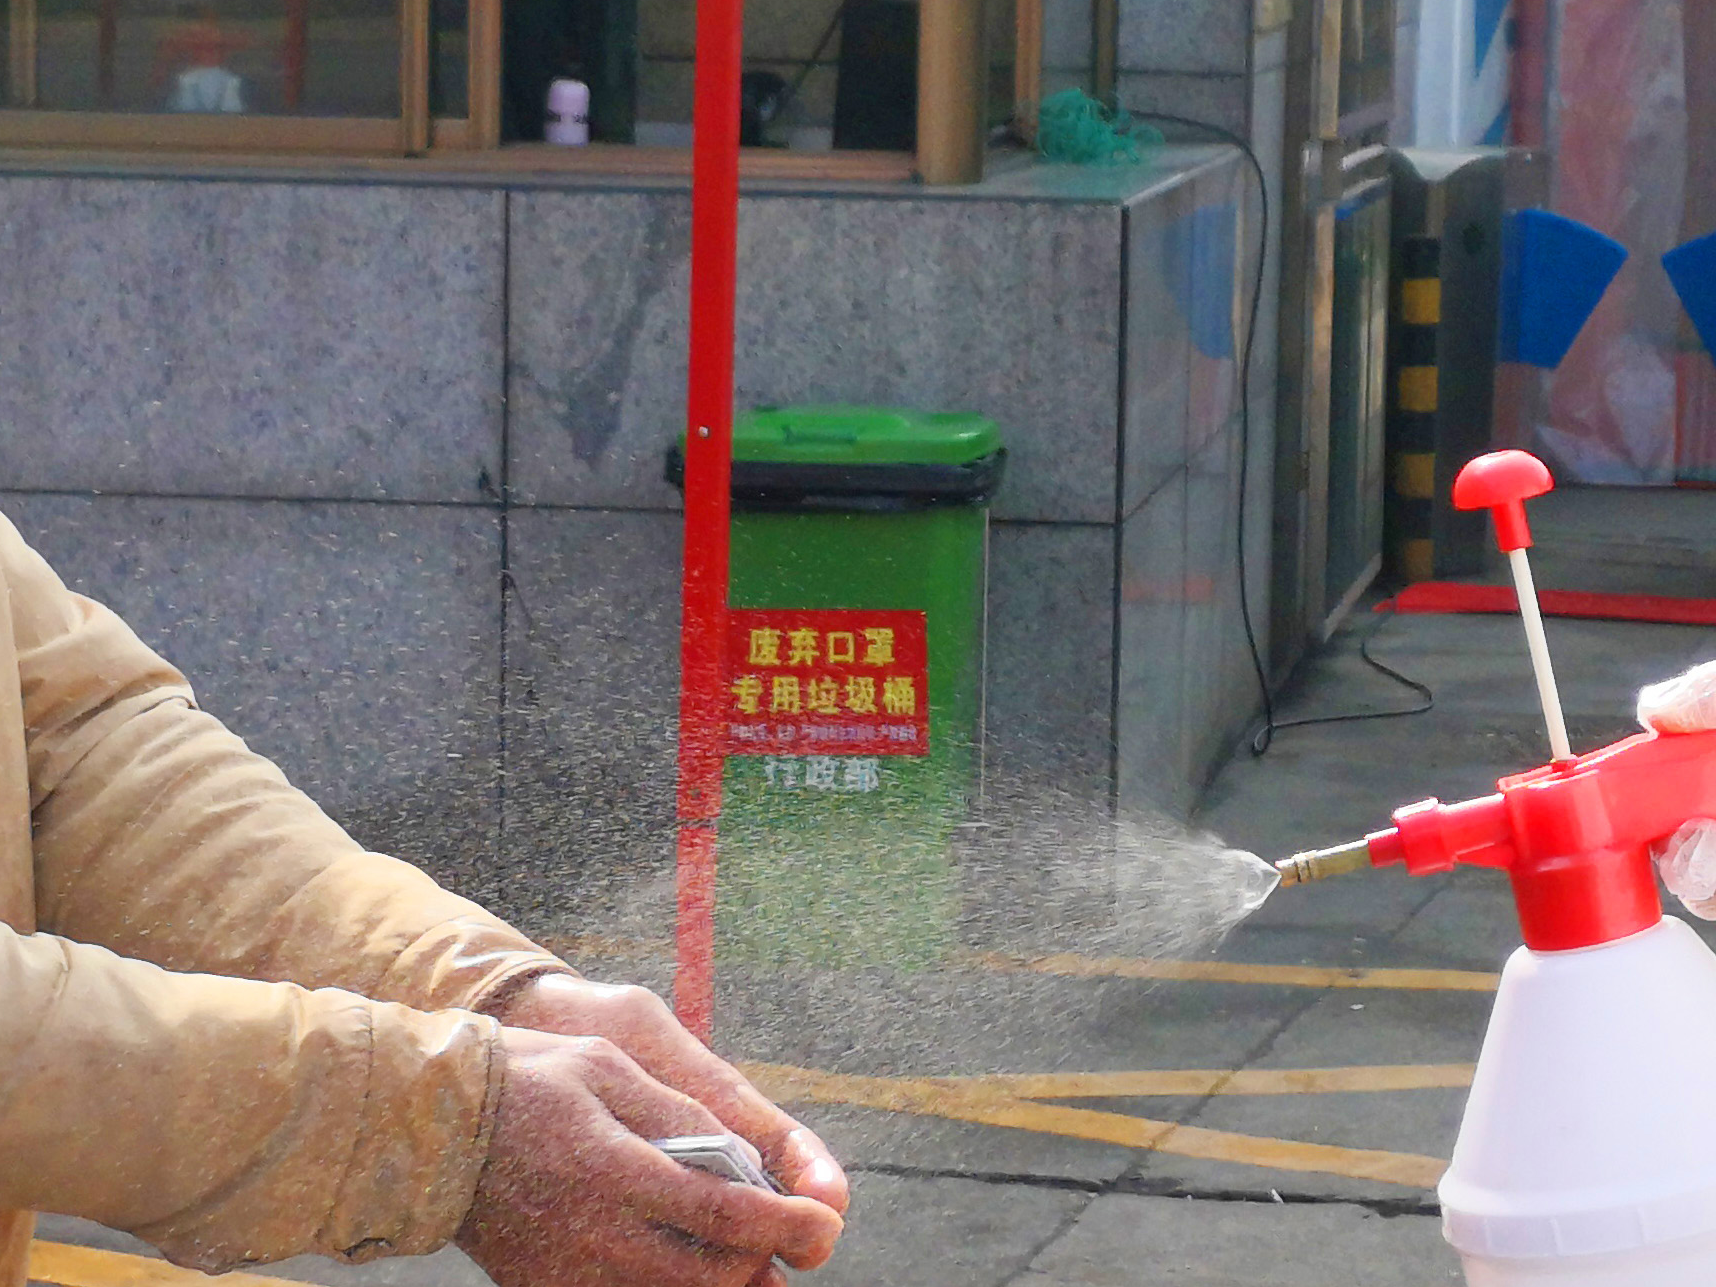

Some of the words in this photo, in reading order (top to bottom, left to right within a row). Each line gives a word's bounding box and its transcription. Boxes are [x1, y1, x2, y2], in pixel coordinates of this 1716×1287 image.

[748, 627, 895, 667] 废弃口罩
[731, 675, 916, 715] 专用垃圾桶
